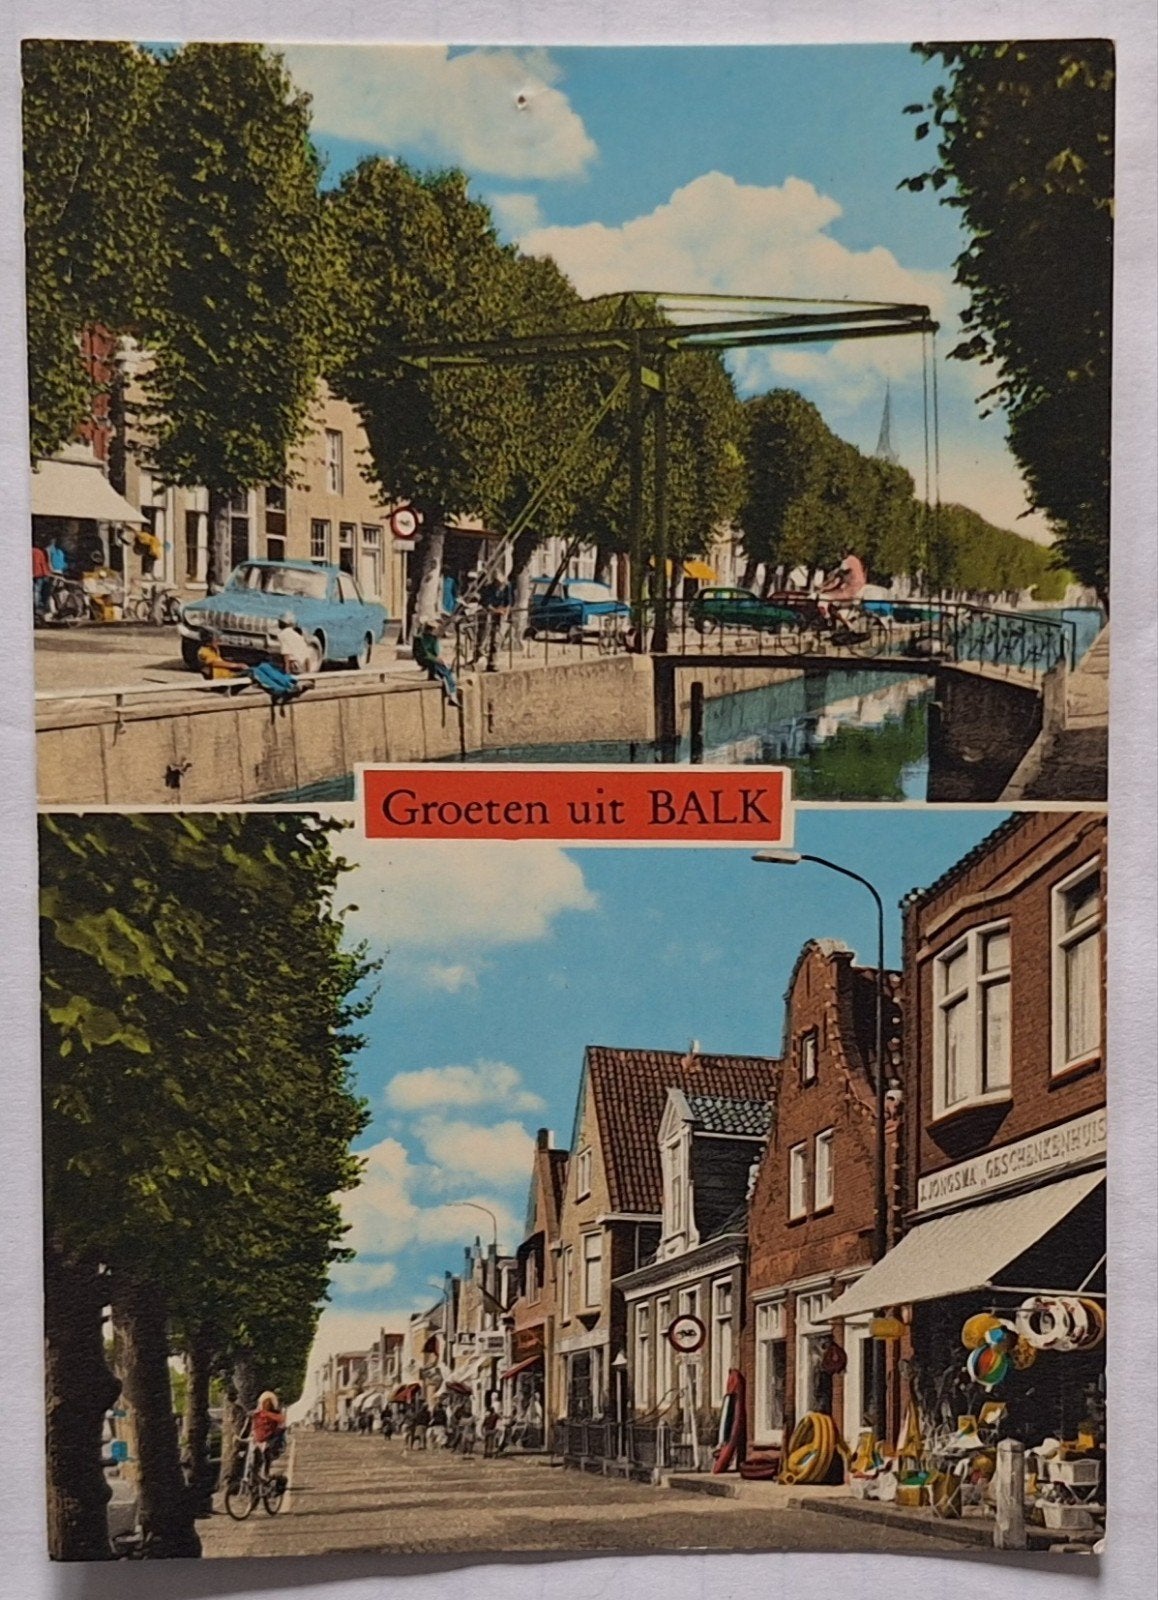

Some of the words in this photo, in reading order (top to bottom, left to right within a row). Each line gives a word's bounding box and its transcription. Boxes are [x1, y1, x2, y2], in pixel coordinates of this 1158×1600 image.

[382, 788, 549, 825] Groeten
[568, 787, 625, 825] uit
[648, 788, 771, 825] BALK
